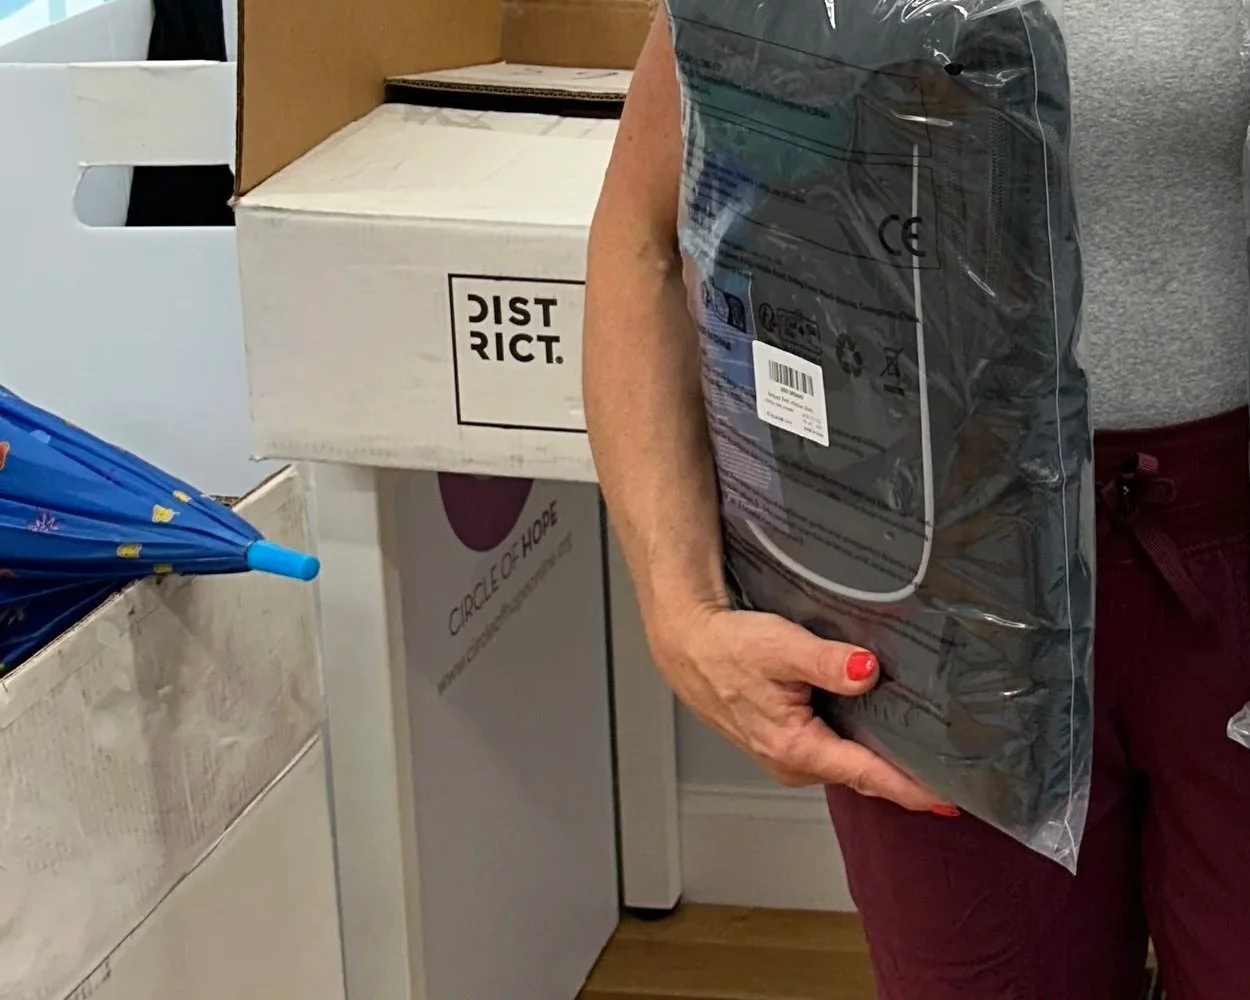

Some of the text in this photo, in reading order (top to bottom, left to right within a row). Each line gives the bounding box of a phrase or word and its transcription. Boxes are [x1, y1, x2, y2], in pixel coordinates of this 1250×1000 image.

[467, 293, 558, 328] DIST
[449, 500, 558, 636] CIRCLE OF HOPE
